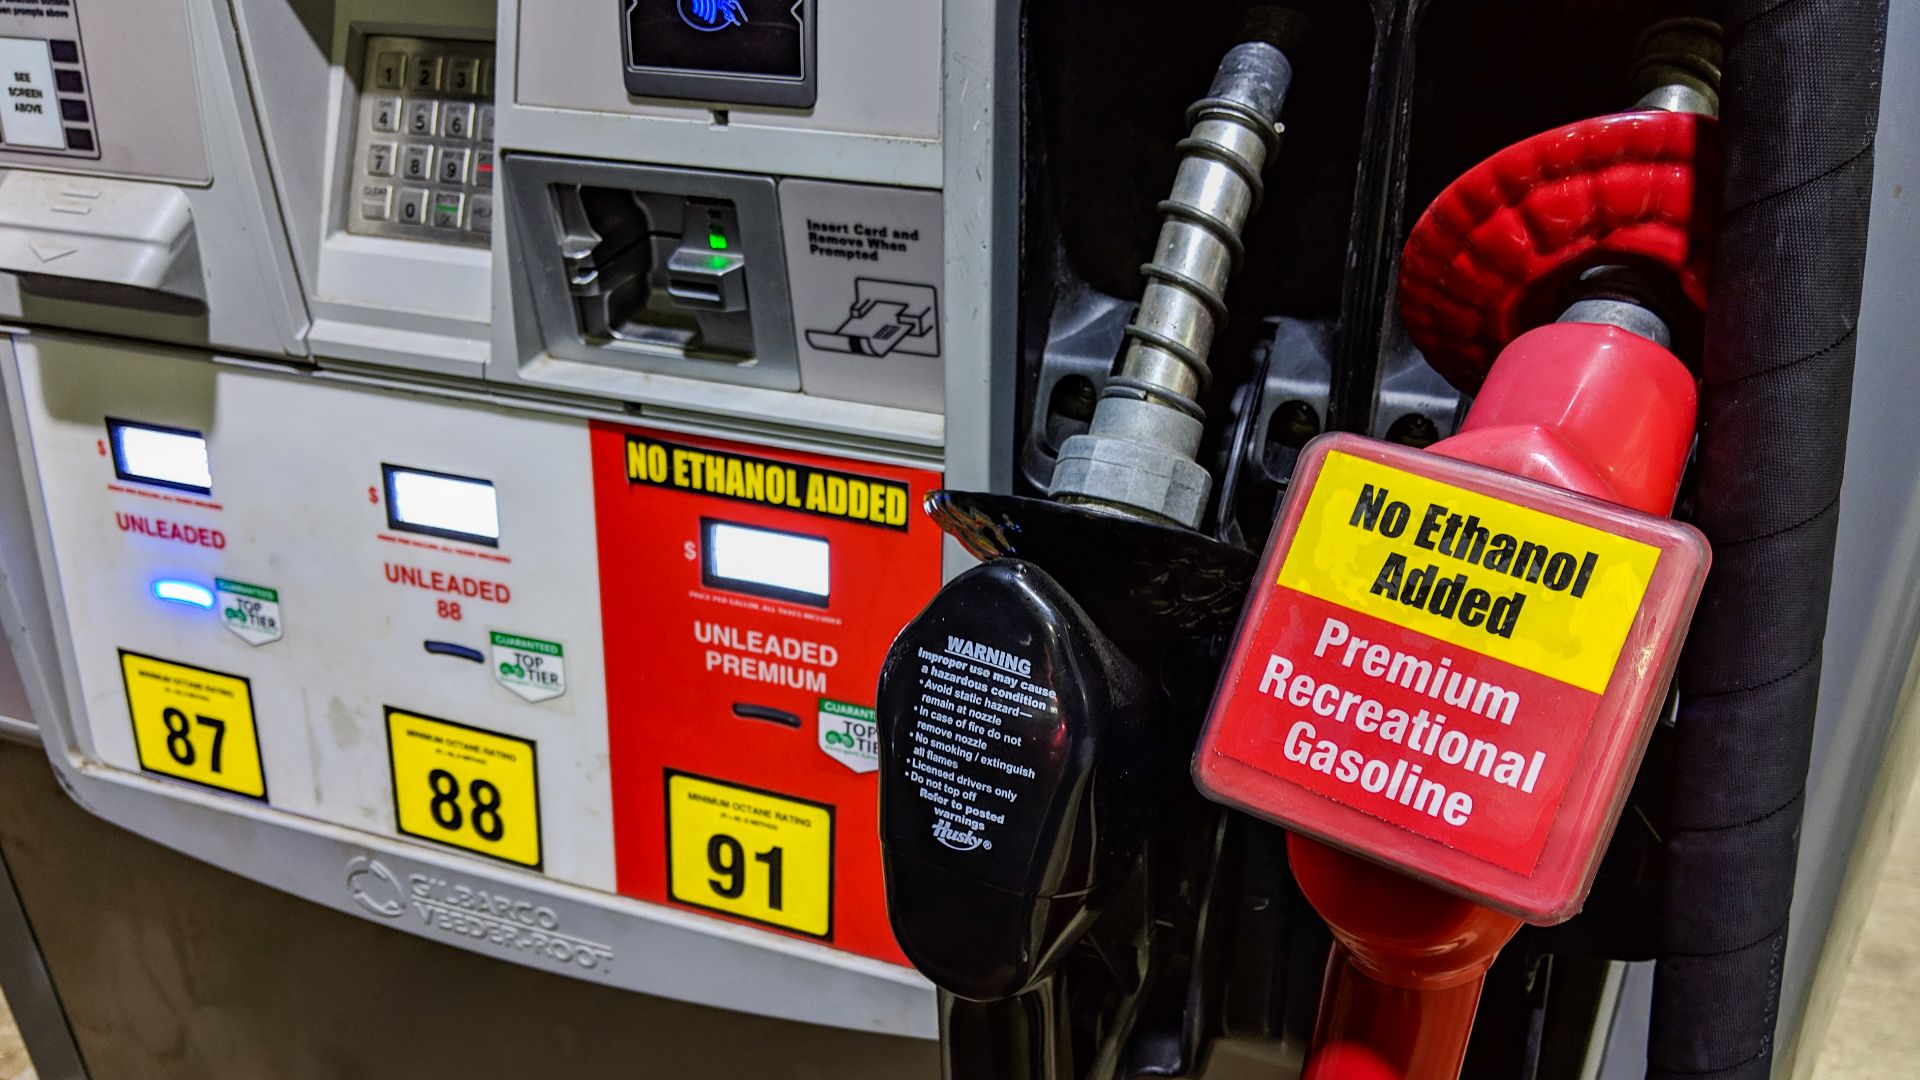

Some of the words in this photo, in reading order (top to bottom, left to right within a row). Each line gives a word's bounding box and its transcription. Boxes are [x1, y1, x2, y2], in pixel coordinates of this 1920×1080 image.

[14, 72, 31, 83] SEE
[384, 67, 392, 82] 1
[420, 70, 430, 86] 2
[456, 72, 466, 88] 3
[8, 86, 43, 98] SCREEN
[15, 103, 44, 115] ABOVE
[379, 112, 388, 127] 4
[416, 115, 424, 130] 5
[452, 118, 462, 133] 6
[375, 155, 385, 171] 7
[410, 159, 420, 174] 8
[447, 162, 456, 178] 9
[404, 202, 415, 218] 0
[806, 219, 849, 235] Insert
[854, 224, 887, 238] Card
[893, 230, 920, 241] and
[808, 232, 864, 248] Remove
[868, 238, 907, 252] When
[810, 244, 878, 262] Prompted
[368, 486, 379, 504] $
[627, 440, 668, 483] NO
[673, 448, 802, 508] ETHANOL
[806, 472, 907, 526] ADDED
[116, 511, 226, 550] UNLEADED
[1348, 483, 1412, 540] No
[1414, 503, 1600, 600] Ethanol
[684, 540, 697, 560] $
[384, 562, 512, 604] UNLEADED
[1370, 552, 1528, 640] Added
[436, 600, 462, 621] 88
[694, 620, 838, 668] UNLEADED
[946, 635, 1032, 676] WARNING
[514, 653, 544, 668] TOP
[706, 651, 827, 694] PREMIUM
[918, 646, 968, 672] Improper
[970, 665, 990, 678] use
[992, 672, 1018, 688] may
[1020, 681, 1057, 700] cause
[1313, 617, 1521, 726] Premium
[526, 670, 558, 686] TIER
[920, 666, 928, 674] a
[930, 666, 988, 692] hazardous
[990, 686, 1046, 711] condition
[924, 679, 952, 697] Avoid
[954, 688, 983, 706] static
[922, 694, 955, 712] remain
[956, 704, 968, 714] at
[969, 709, 1002, 726] nozzle
[917, 720, 953, 740] remove
[955, 732, 988, 750] nozzle
[920, 706, 928, 716] In
[930, 712, 954, 725] case
[956, 717, 966, 730] of
[968, 721, 986, 736] fire
[988, 727, 1001, 740] do
[1004, 734, 1022, 747] not
[1258, 654, 1547, 795] Recreational
[162, 707, 226, 774] 87
[913, 746, 925, 757] all
[926, 752, 959, 770] flames
[916, 731, 928, 745] No
[930, 739, 973, 762] smoking
[974, 751, 980, 762] /
[980, 755, 1036, 780] extinguish
[911, 771, 924, 783] Do
[926, 776, 942, 790] not
[944, 780, 960, 798] top
[962, 789, 978, 802] off
[912, 757, 955, 782] Licensed
[956, 770, 992, 792] drivers
[994, 788, 1018, 804] only
[1283, 720, 1475, 827] Gasoline
[428, 768, 504, 843] 88
[688, 792, 730, 810] MINIMUM
[732, 802, 772, 819] OCTANE
[775, 811, 812, 828] RATING
[920, 788, 949, 806] Refer
[951, 798, 962, 811] to
[965, 804, 1005, 825] posted
[934, 806, 986, 831] warnings
[707, 833, 784, 912] 91
